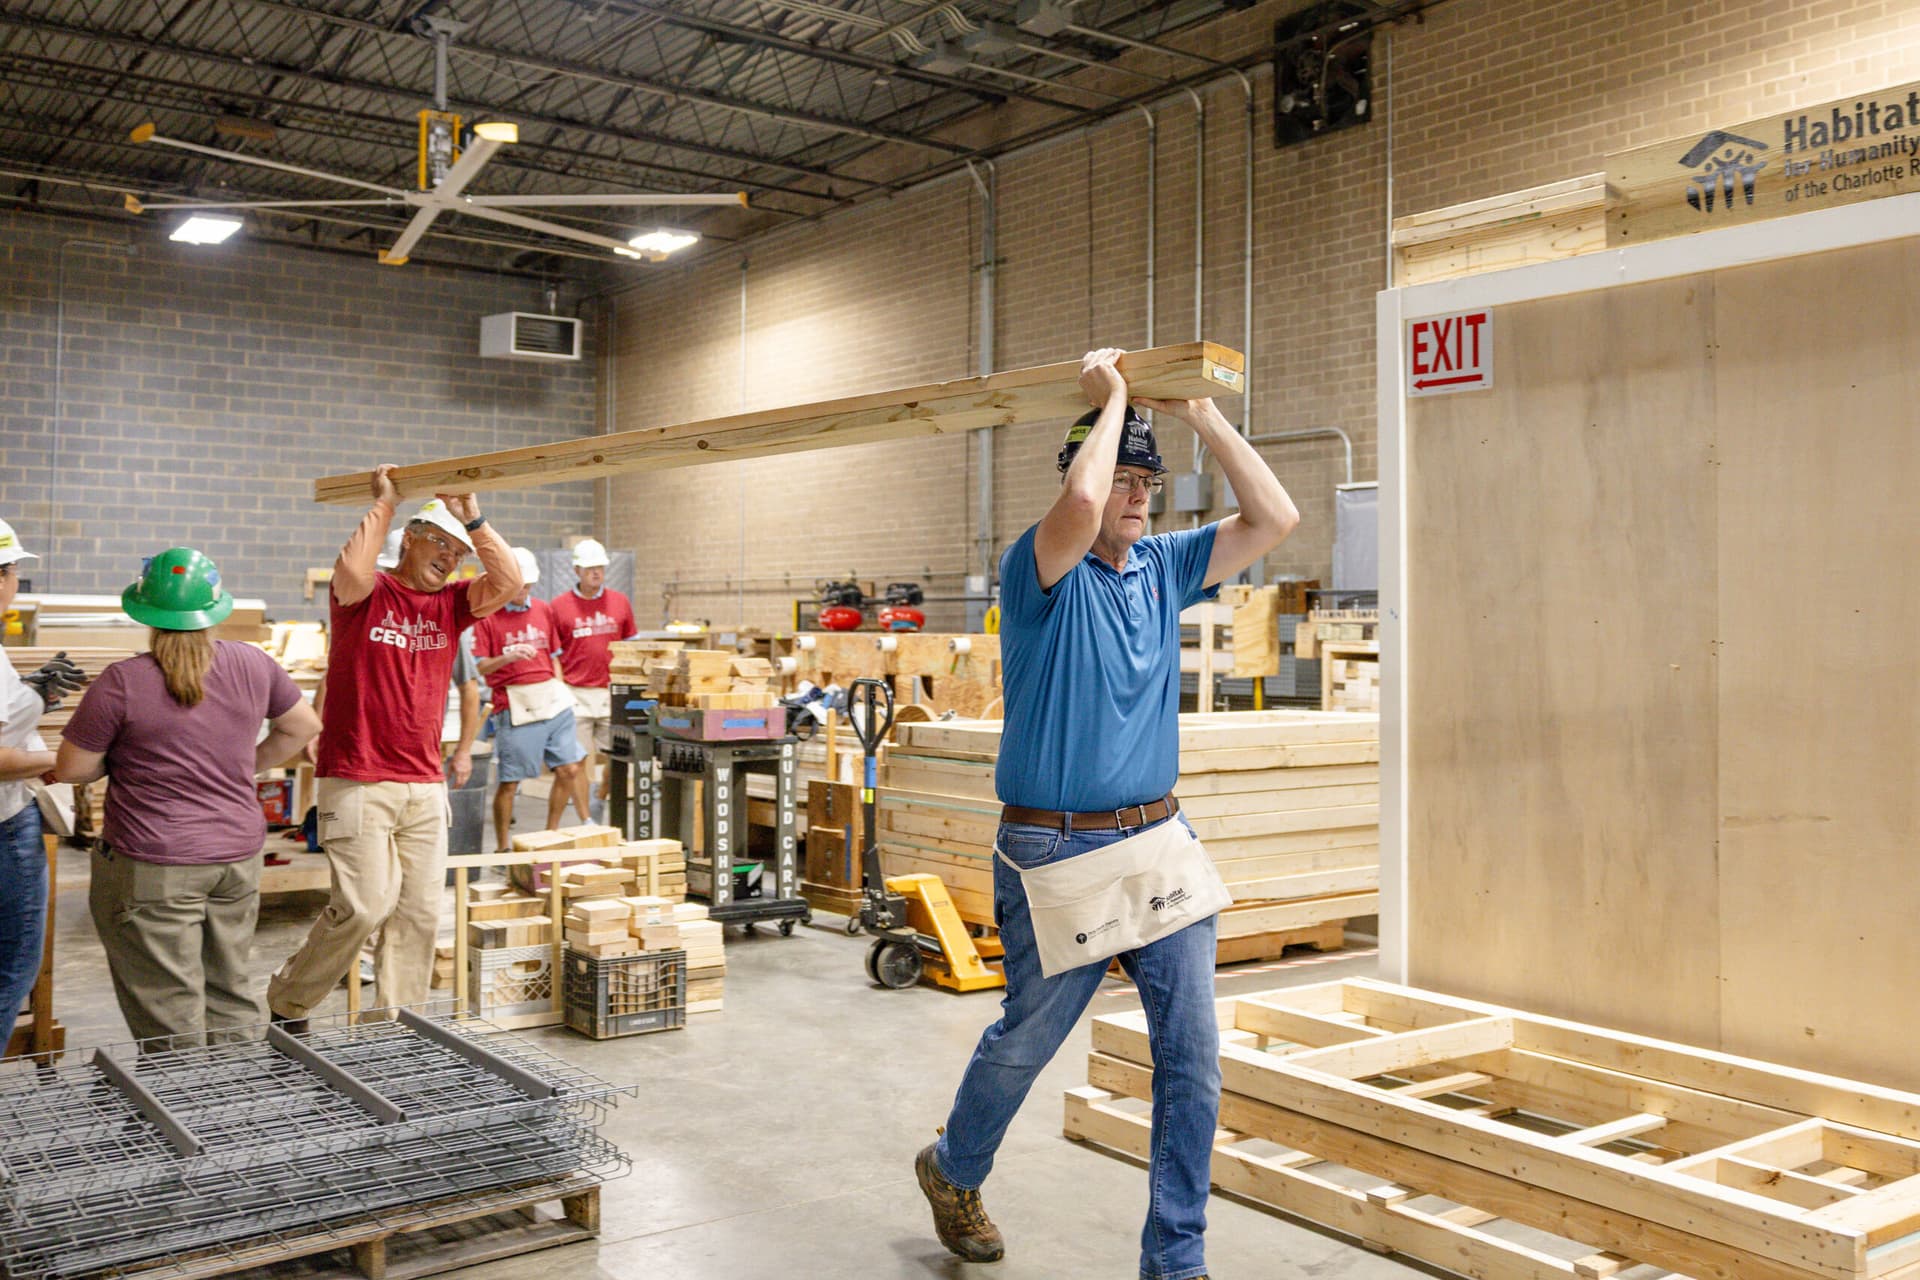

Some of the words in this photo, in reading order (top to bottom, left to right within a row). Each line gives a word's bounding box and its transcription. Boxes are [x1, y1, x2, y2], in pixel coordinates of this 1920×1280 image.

[1784, 92, 1920, 154] Habitat
[1820, 135, 1920, 171] Humanity
[1785, 183, 1800, 201] of
[1804, 181, 1828, 198] the
[1832, 165, 1904, 191] Charlotte
[1412, 312, 1486, 375] EXIT
[369, 626, 408, 649] CEO
[782, 743, 794, 825] BUILD
[715, 767, 730, 903] WOODSHOP
[782, 836, 794, 898] CART
